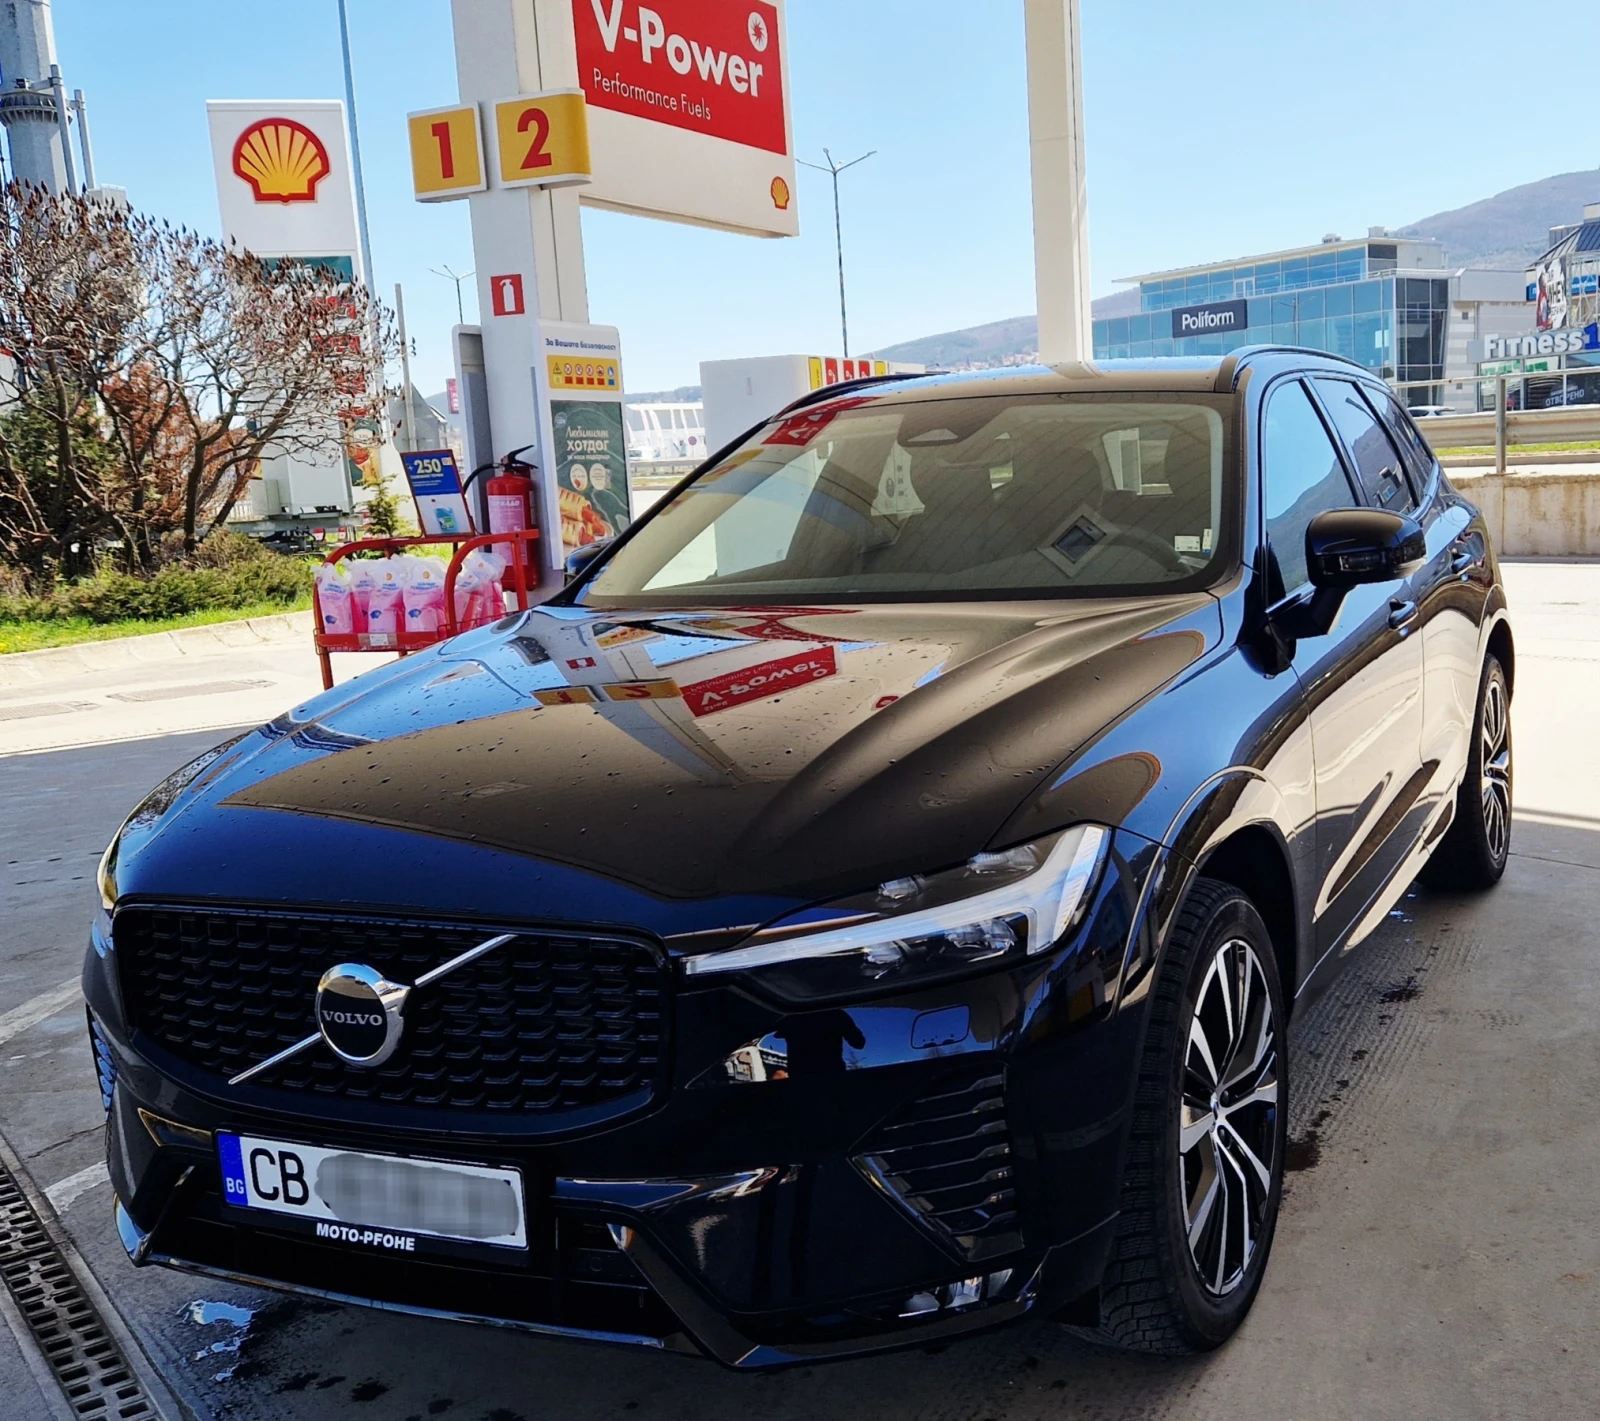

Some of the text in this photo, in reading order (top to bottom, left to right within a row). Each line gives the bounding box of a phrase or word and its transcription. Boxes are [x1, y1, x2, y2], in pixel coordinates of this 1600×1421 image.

[591, 0, 763, 97] V-Power
[593, 67, 711, 121] Performance Fuels
[431, 121, 454, 179] 1
[517, 108, 552, 170] 2
[1181, 309, 1235, 330] Poliform
[545, 337, 554, 346] За
[554, 338, 580, 349] Вашата
[321, 1010, 383, 1026] VOLVO
[225, 1177, 245, 1195] BG
[249, 1148, 309, 1206] CB
[316, 1222, 415, 1251] MOTO-PFOHE
